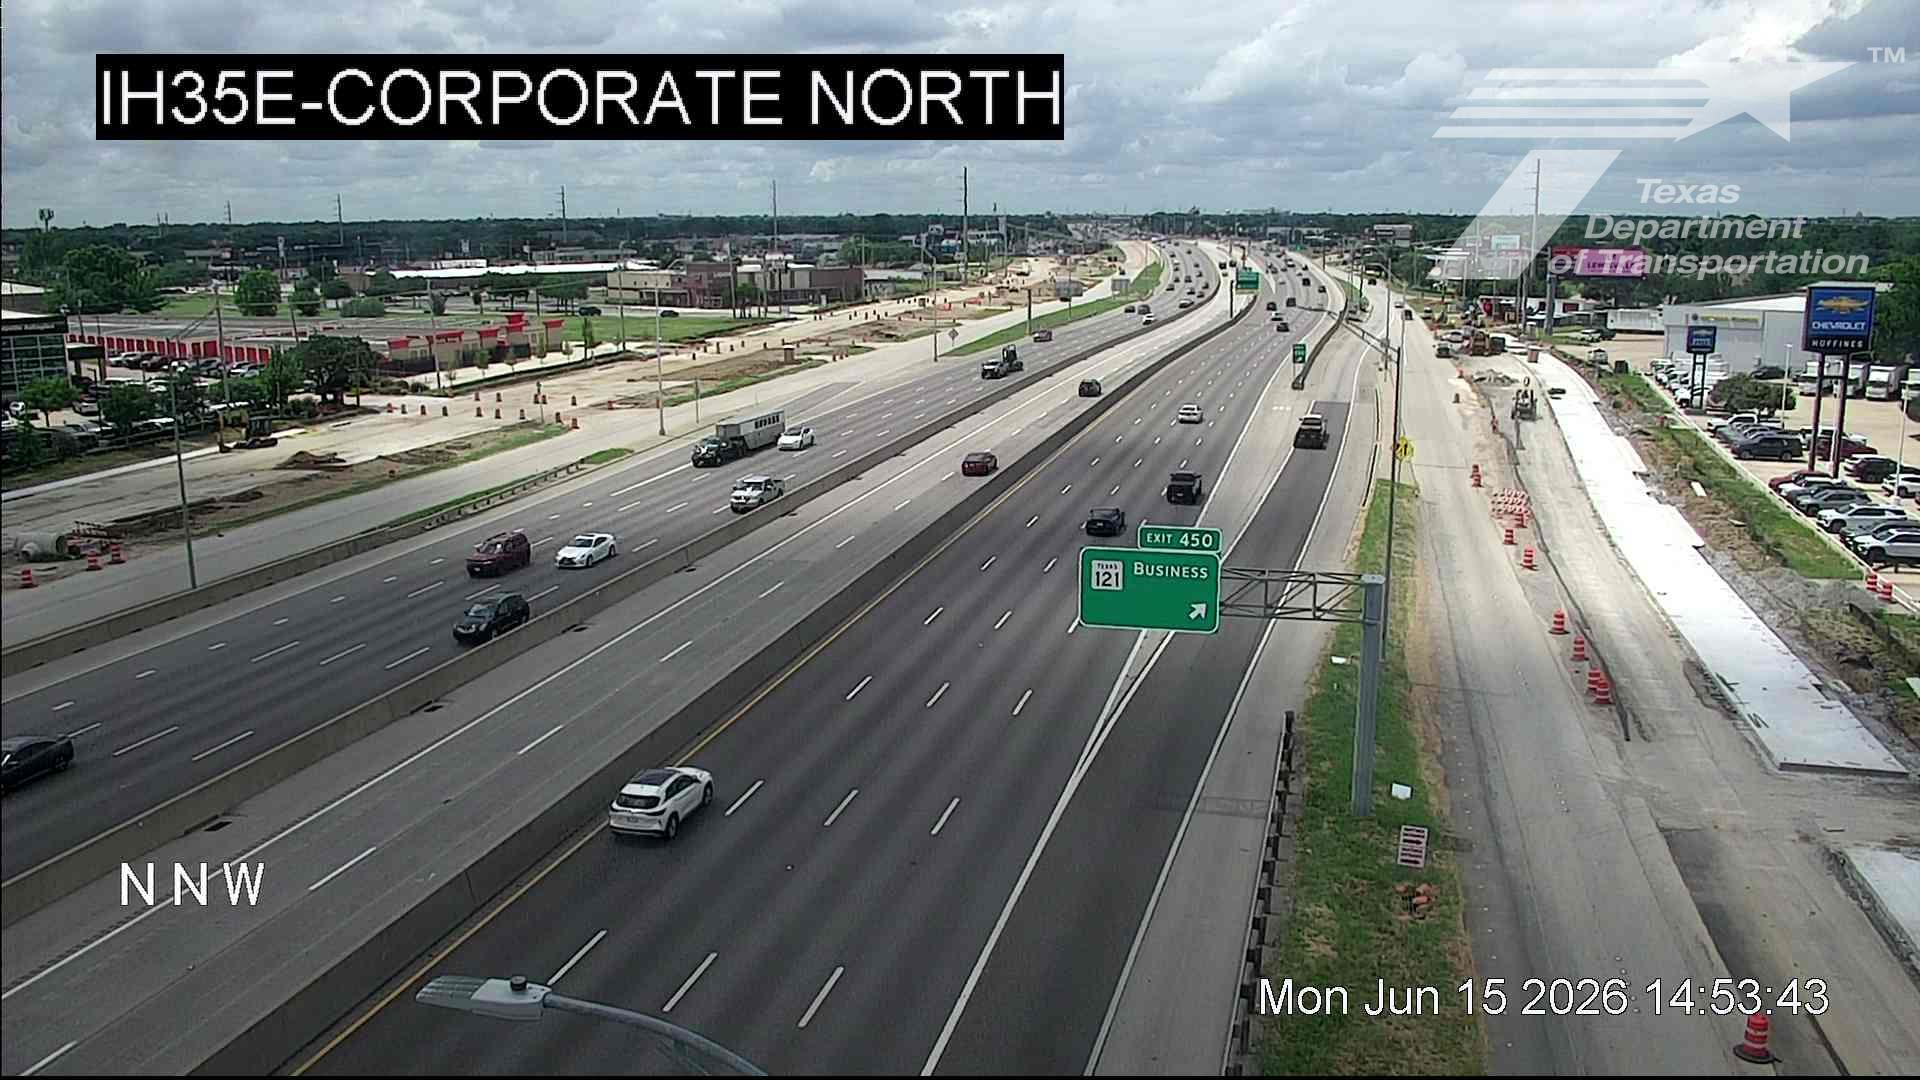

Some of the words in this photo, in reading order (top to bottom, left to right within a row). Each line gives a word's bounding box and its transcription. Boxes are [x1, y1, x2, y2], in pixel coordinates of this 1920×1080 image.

[1812, 321, 1866, 330] CHEVROLET
[1146, 533, 1173, 544] EXIT
[1179, 532, 1213, 548] 450
[1133, 561, 1209, 579] BUSINESS
[1095, 571, 1120, 588] 121
